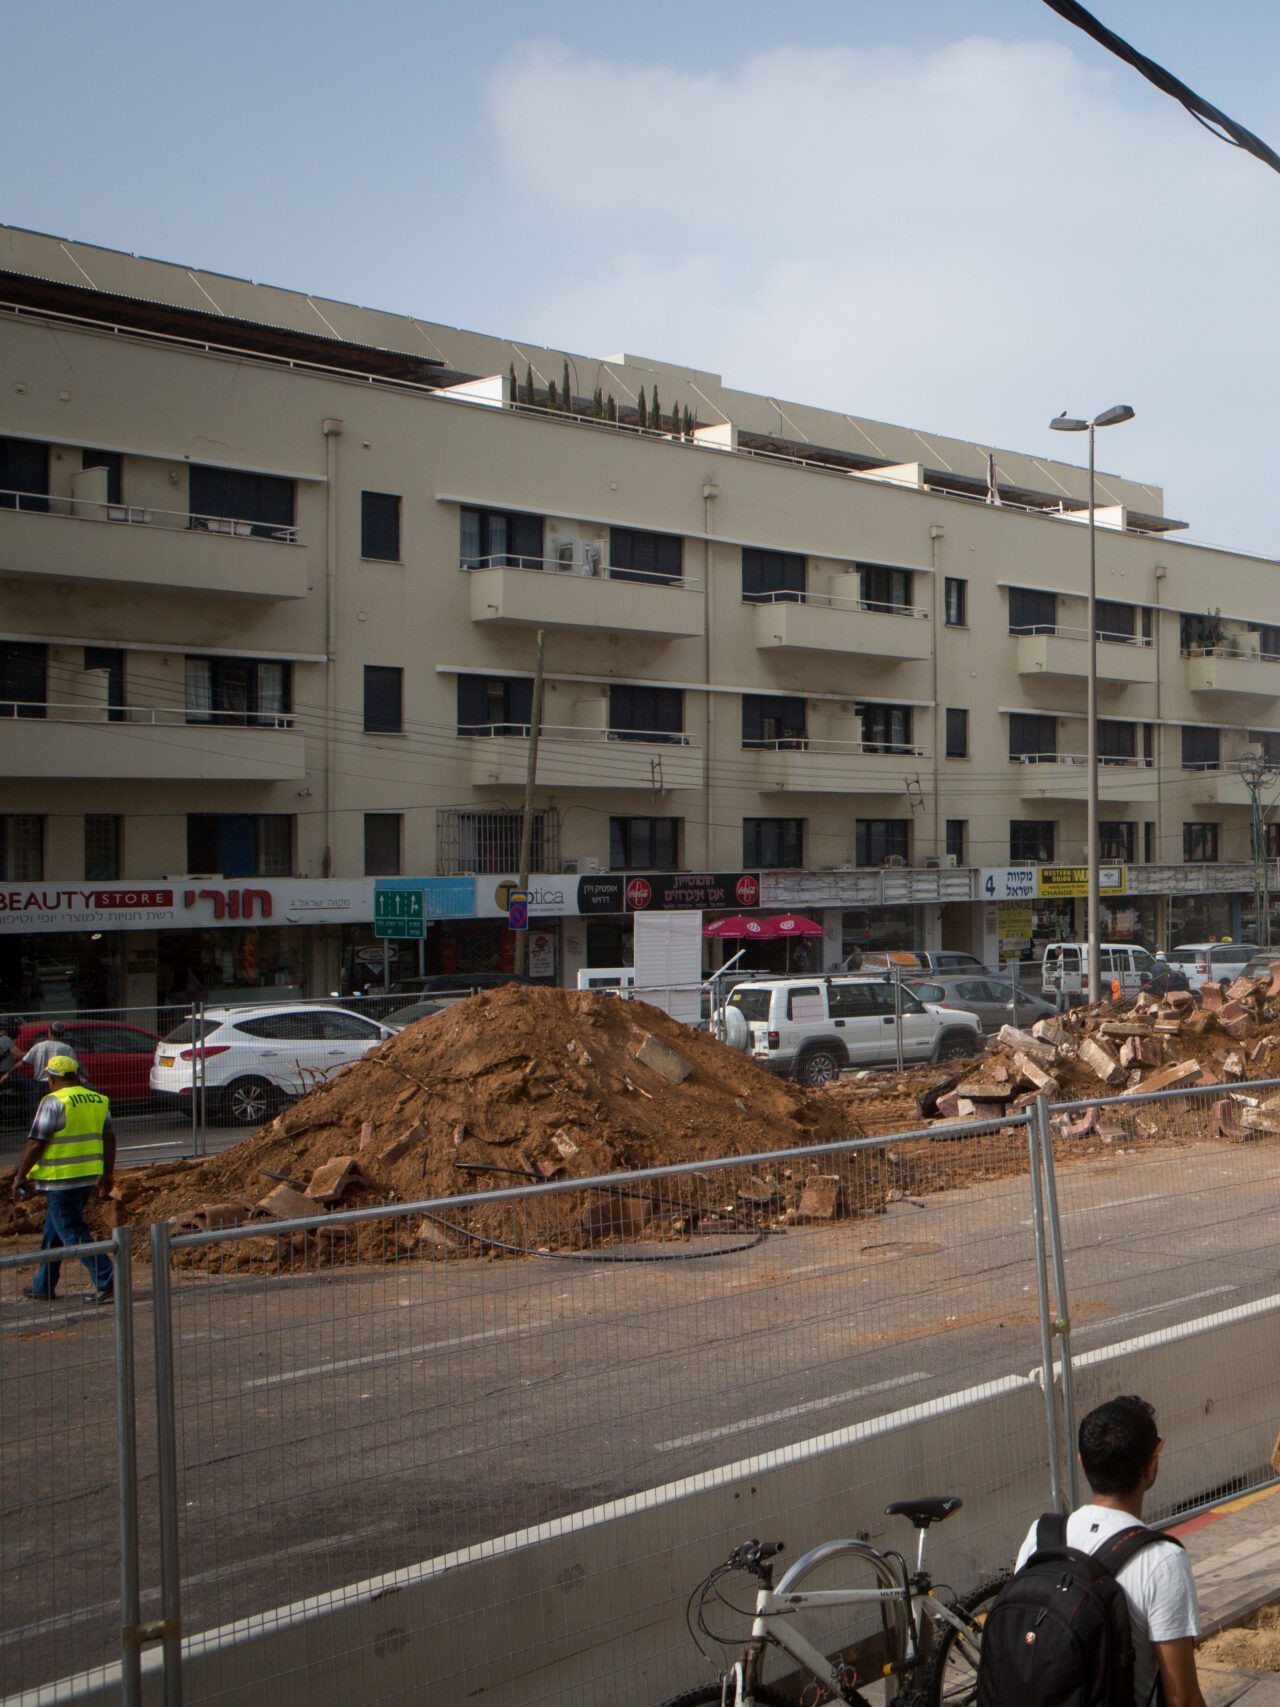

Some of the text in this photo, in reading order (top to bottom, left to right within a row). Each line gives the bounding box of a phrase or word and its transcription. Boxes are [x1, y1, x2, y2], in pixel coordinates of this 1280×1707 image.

[1006, 870, 1033, 885] מקווה
[985, 875, 995, 896] 4
[1005, 885, 1033, 897] ישראל
[102, 893, 165, 905] STORE
[1042, 889, 1074, 897] CHANGE
[0, 891, 95, 911] BEAUTY
[184, 888, 273, 920] חורי
[0, 911, 174, 924] רשת חנויות למוצרי יופי וטיפו
[69, 1094, 103, 1108] בטחון
